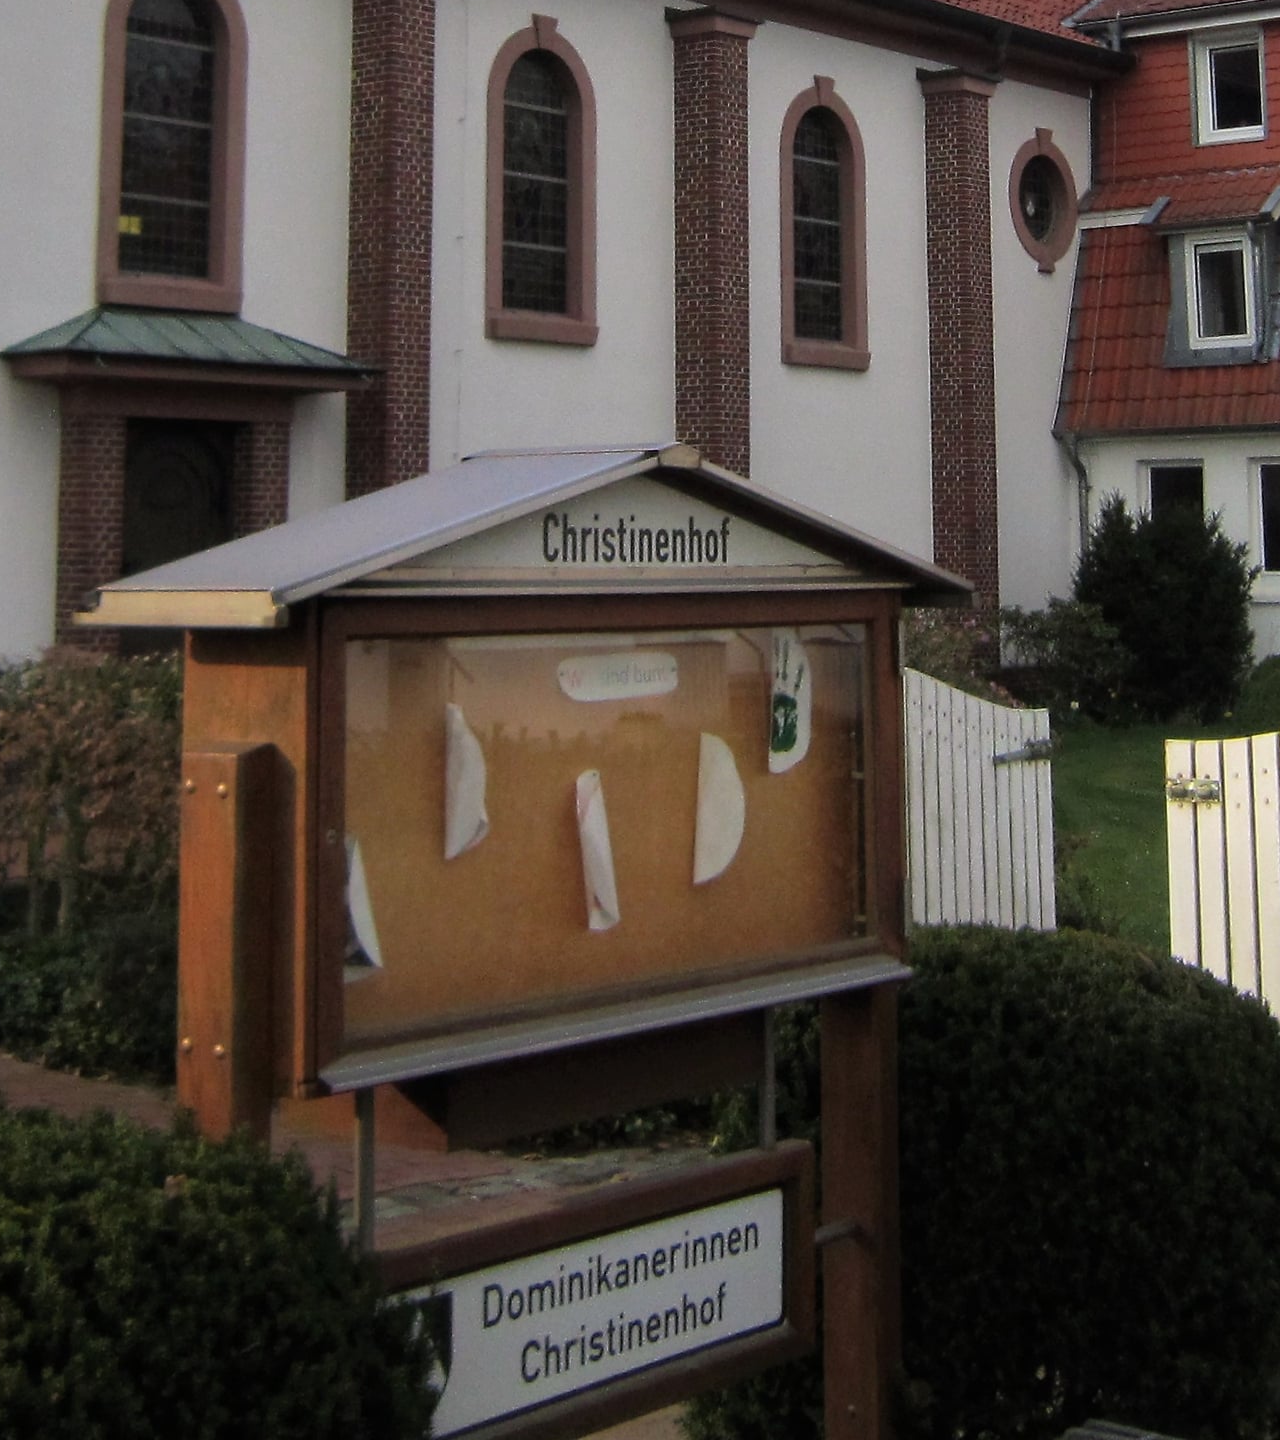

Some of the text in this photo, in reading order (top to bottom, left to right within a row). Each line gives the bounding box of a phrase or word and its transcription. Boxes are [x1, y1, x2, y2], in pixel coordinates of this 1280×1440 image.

[543, 512, 730, 562] Christinenhof
[482, 1221, 760, 1329] Dominikanerinnen
[520, 1281, 727, 1384] Christinenhof
